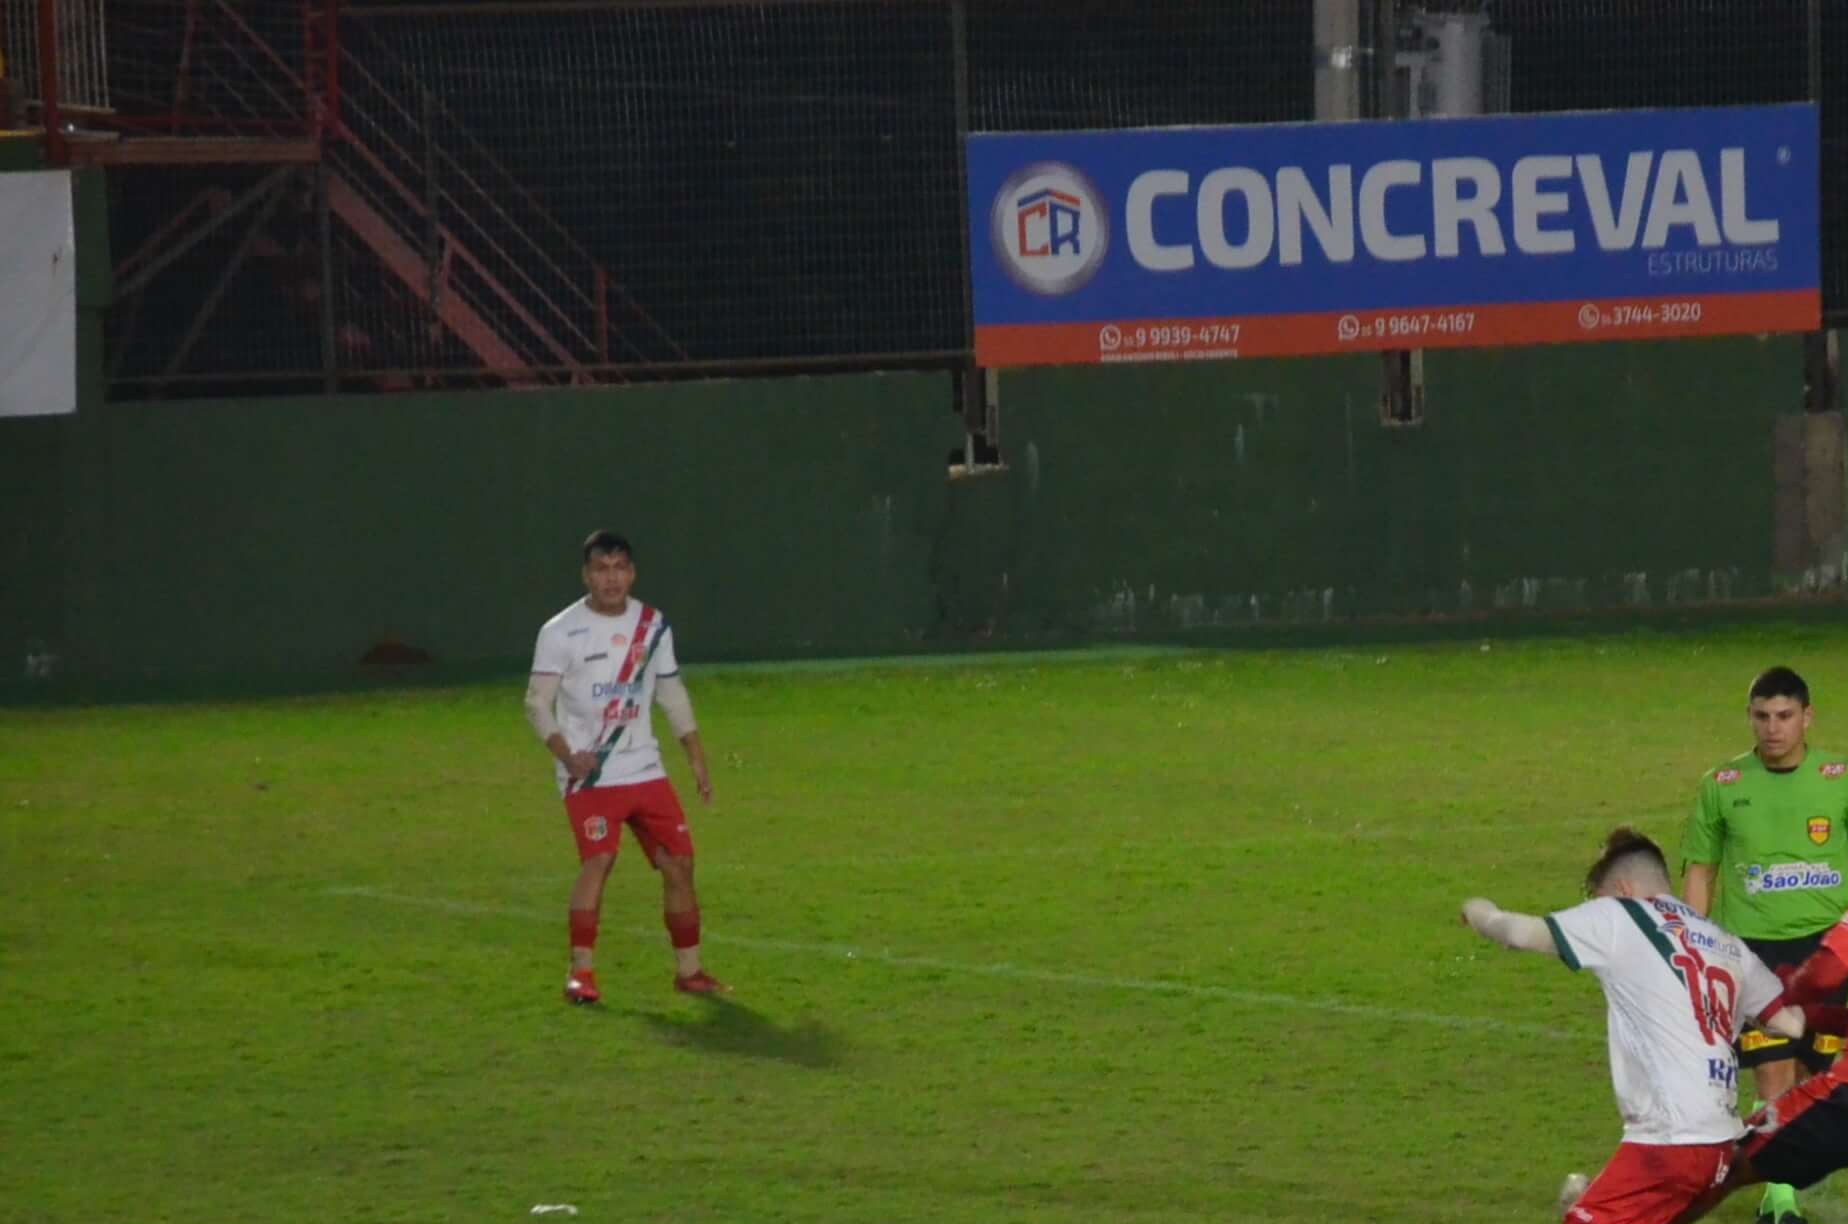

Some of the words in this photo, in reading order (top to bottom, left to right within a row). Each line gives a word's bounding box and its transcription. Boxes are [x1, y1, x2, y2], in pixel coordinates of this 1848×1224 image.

[1125, 147, 1780, 271] CONCREVAL
[1647, 249, 1779, 276] ESTRUTURAS
[1389, 312, 1475, 335] 9647-4167
[1613, 302, 1701, 326] 3744-3020
[1151, 323, 1240, 346] 9939-4747
[1671, 953, 1737, 1047] 10
